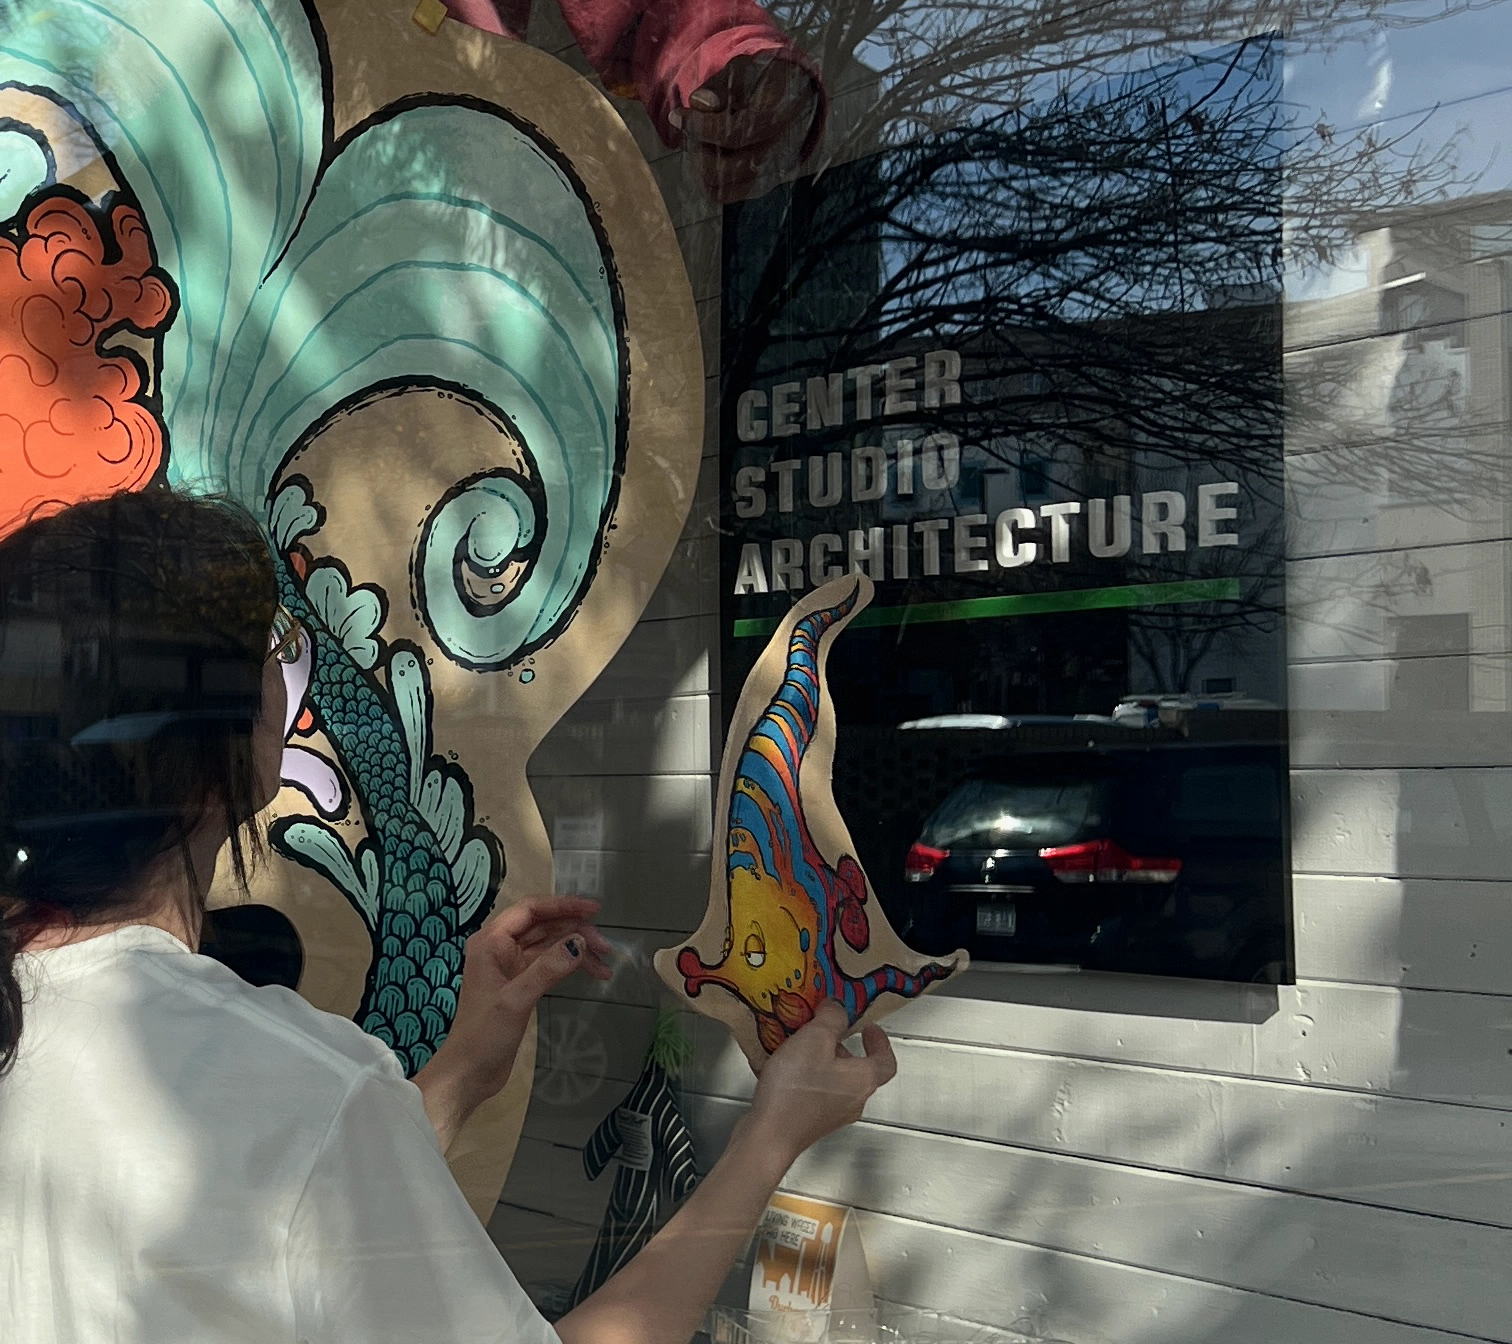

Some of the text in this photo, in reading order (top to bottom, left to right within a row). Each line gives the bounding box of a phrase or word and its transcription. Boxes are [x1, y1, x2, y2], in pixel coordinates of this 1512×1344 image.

[736, 349, 962, 442] CENTER
[734, 432, 961, 519] STUDIO
[733, 482, 1240, 595] ARCHITECTURE
